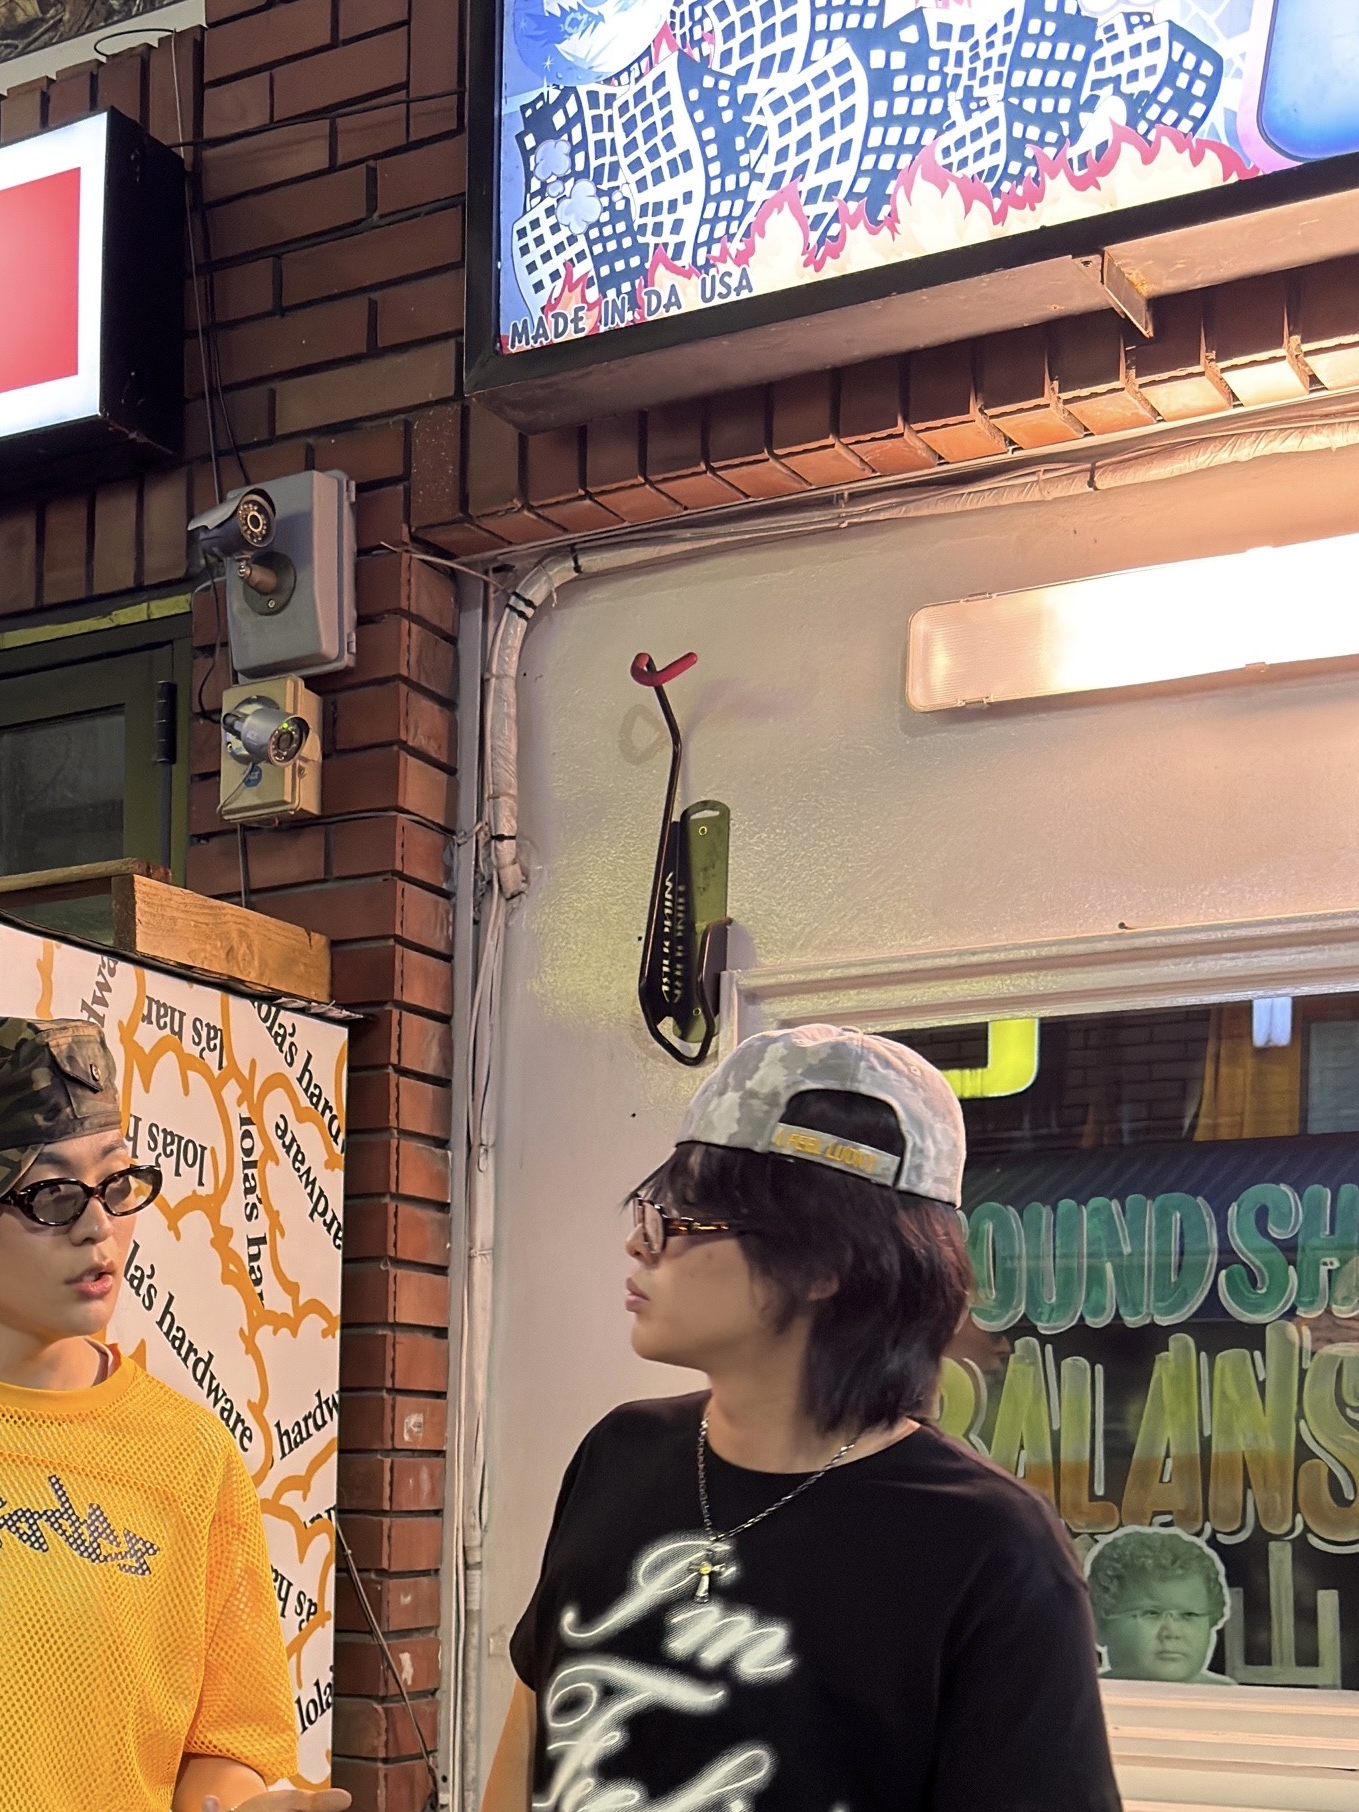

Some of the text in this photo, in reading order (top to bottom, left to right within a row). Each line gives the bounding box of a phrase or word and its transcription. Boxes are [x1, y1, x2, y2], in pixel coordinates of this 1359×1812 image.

[509, 266, 754, 349] MADE IN DA USA
[957, 1192, 1219, 1334] OUND
[155, 1290, 254, 1453] hardware
